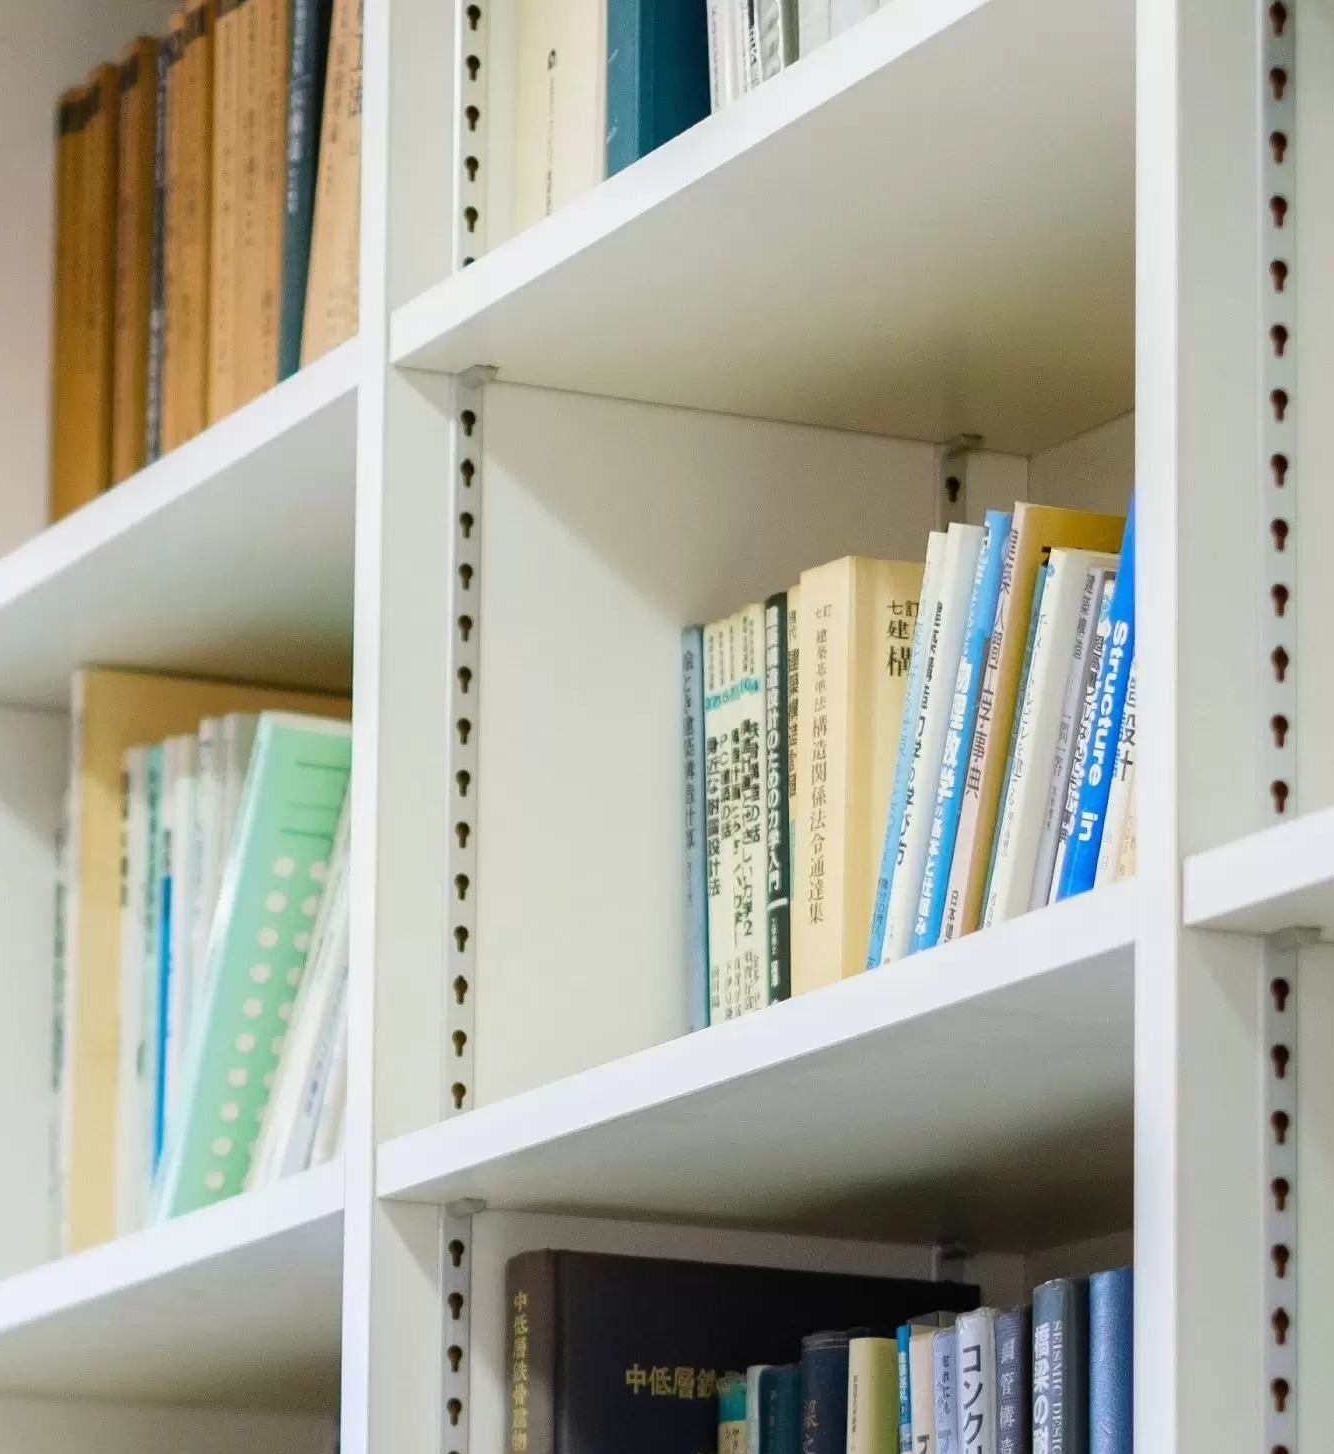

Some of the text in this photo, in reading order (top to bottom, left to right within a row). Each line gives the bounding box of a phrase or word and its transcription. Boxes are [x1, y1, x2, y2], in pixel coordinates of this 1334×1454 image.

[1087, 619, 1130, 788] Structure
[807, 626, 828, 924] 建築基準法構造関係法令通達集
[1077, 810, 1099, 842] in
[1051, 1319, 1064, 1395] SEISMIC
